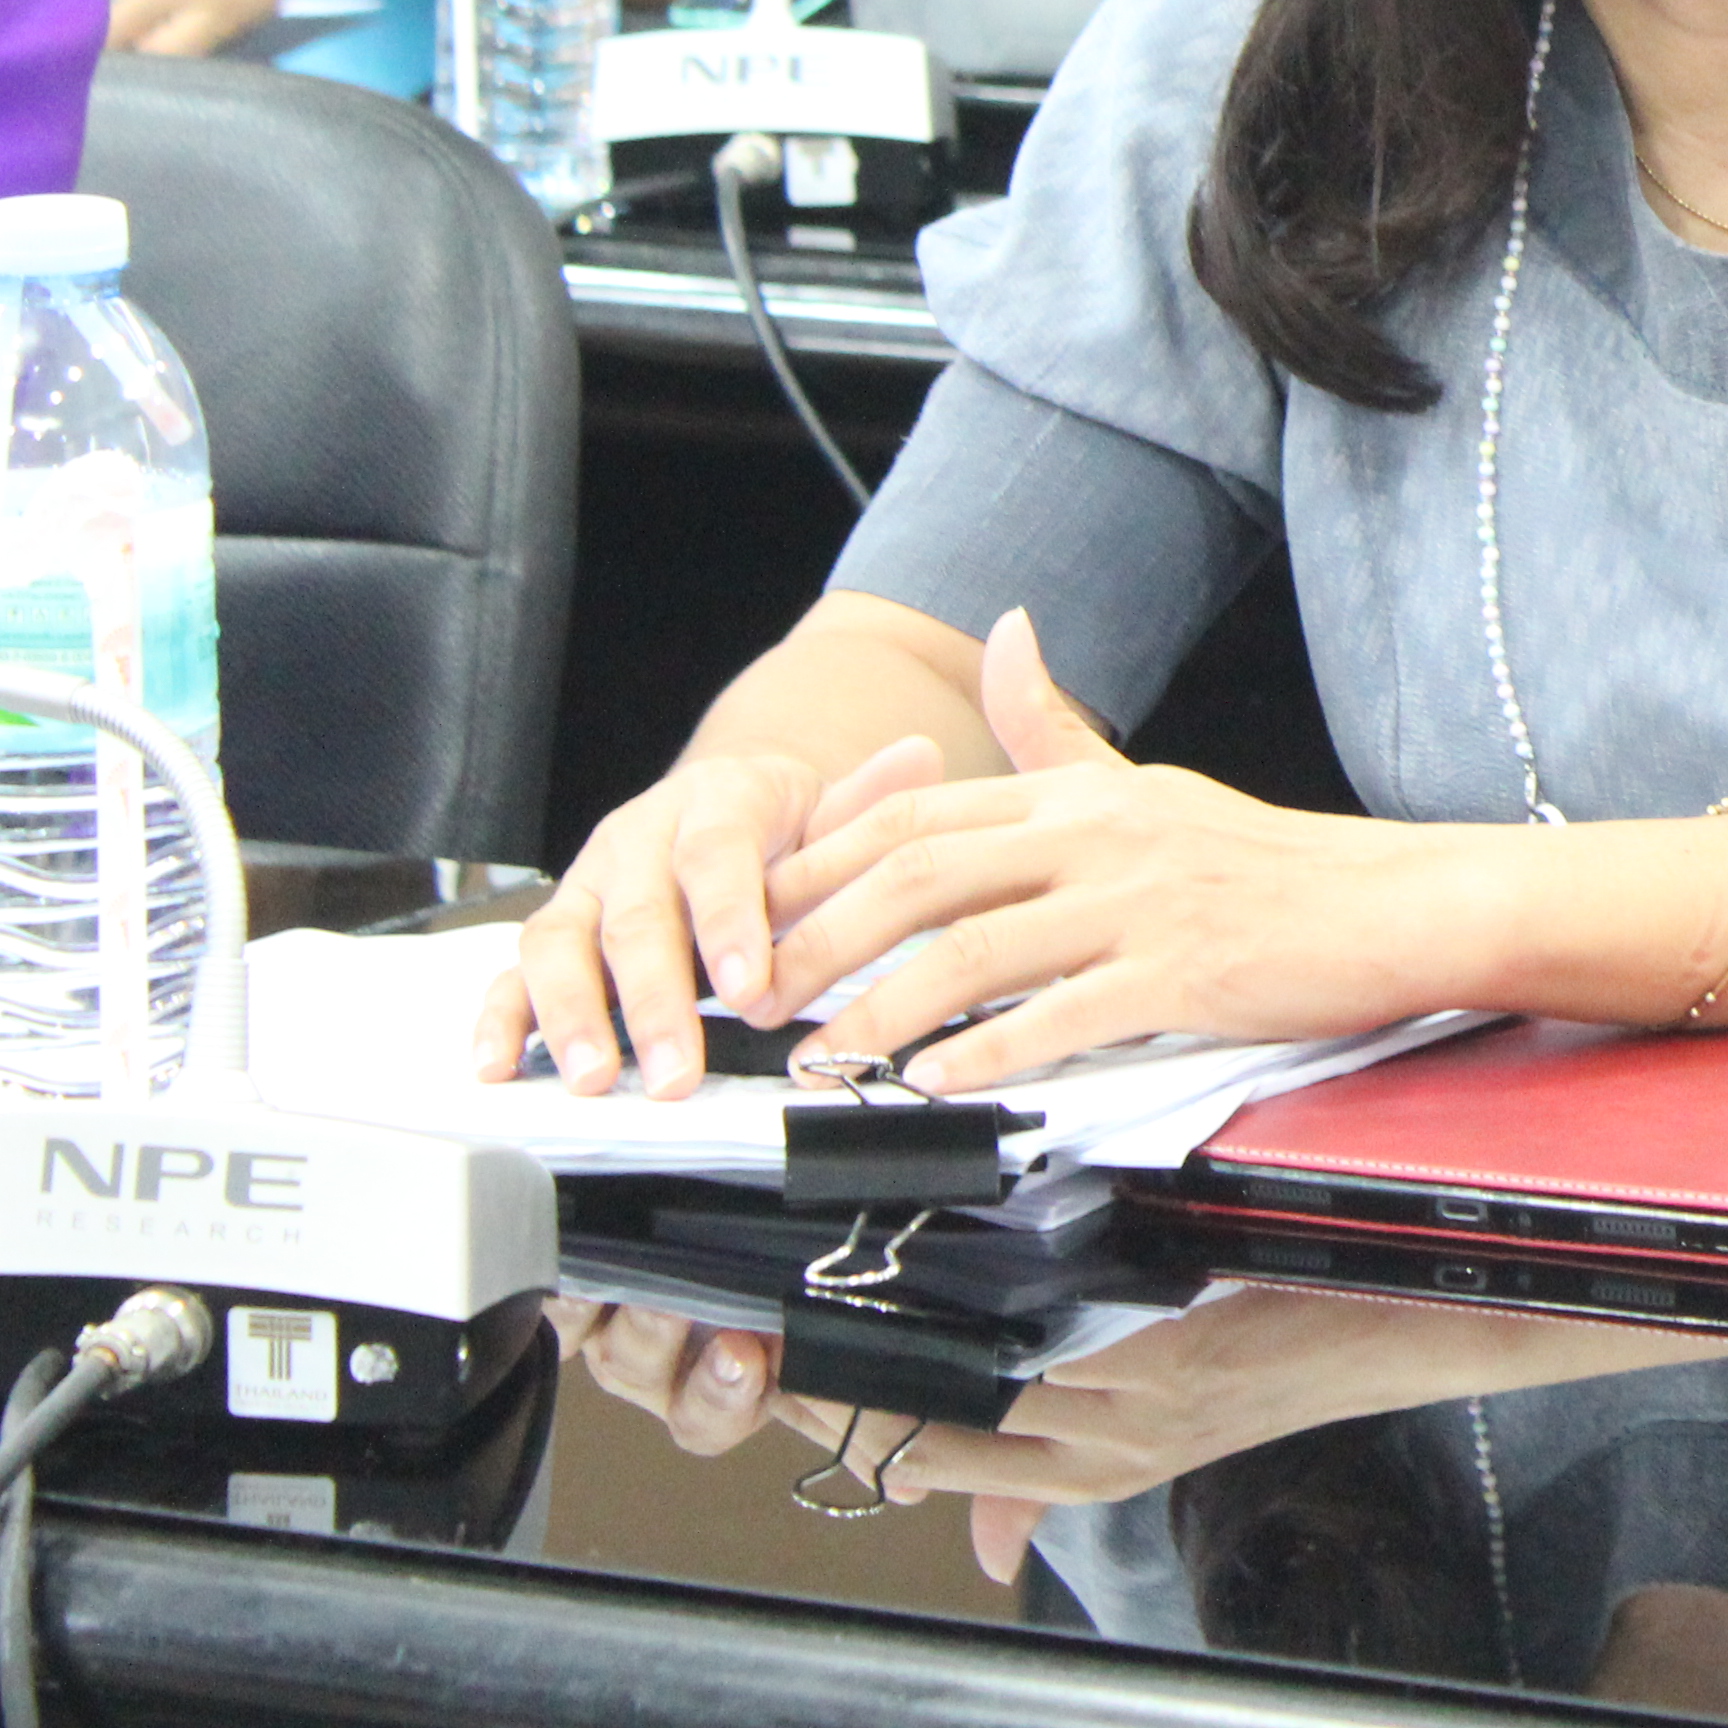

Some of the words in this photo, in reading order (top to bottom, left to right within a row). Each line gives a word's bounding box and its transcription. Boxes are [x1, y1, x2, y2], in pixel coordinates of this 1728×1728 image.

[681, 53, 830, 86] NPE
[40, 1136, 308, 1211] NPE
[36, 1209, 302, 1245] RESEARCH
[233, 1382, 328, 1403] THAILAND
